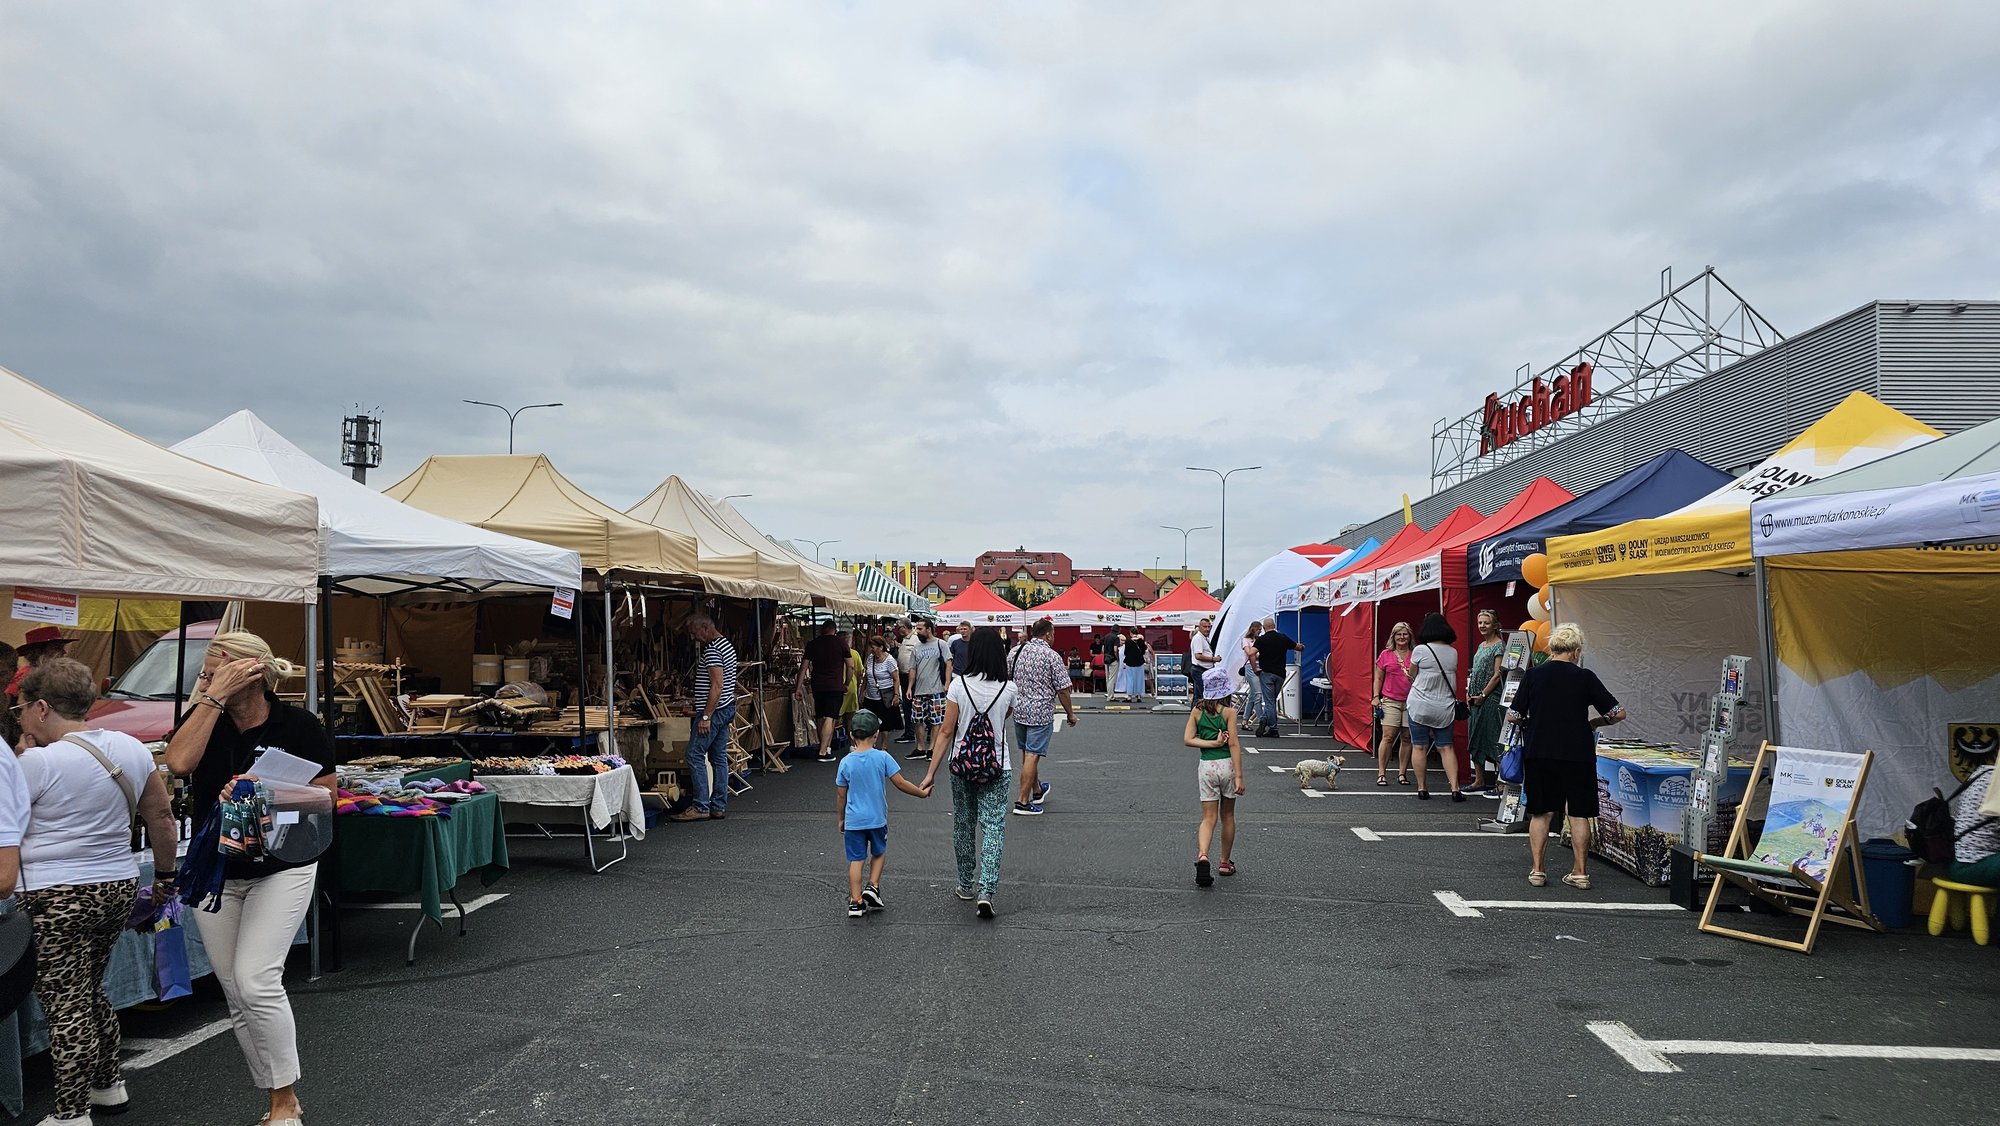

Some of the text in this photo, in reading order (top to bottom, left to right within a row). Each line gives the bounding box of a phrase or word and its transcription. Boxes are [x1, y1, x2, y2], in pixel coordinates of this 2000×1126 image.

[1480, 361, 1592, 458] Auchan
[1774, 504, 1891, 528] www.muzeumkarkonoskie.pl
[1595, 544, 1616, 556] LOWER
[1628, 539, 1649, 550] DOLNY
[1598, 553, 1617, 564] SILESIA
[1654, 793, 1689, 804] SKY WAL
